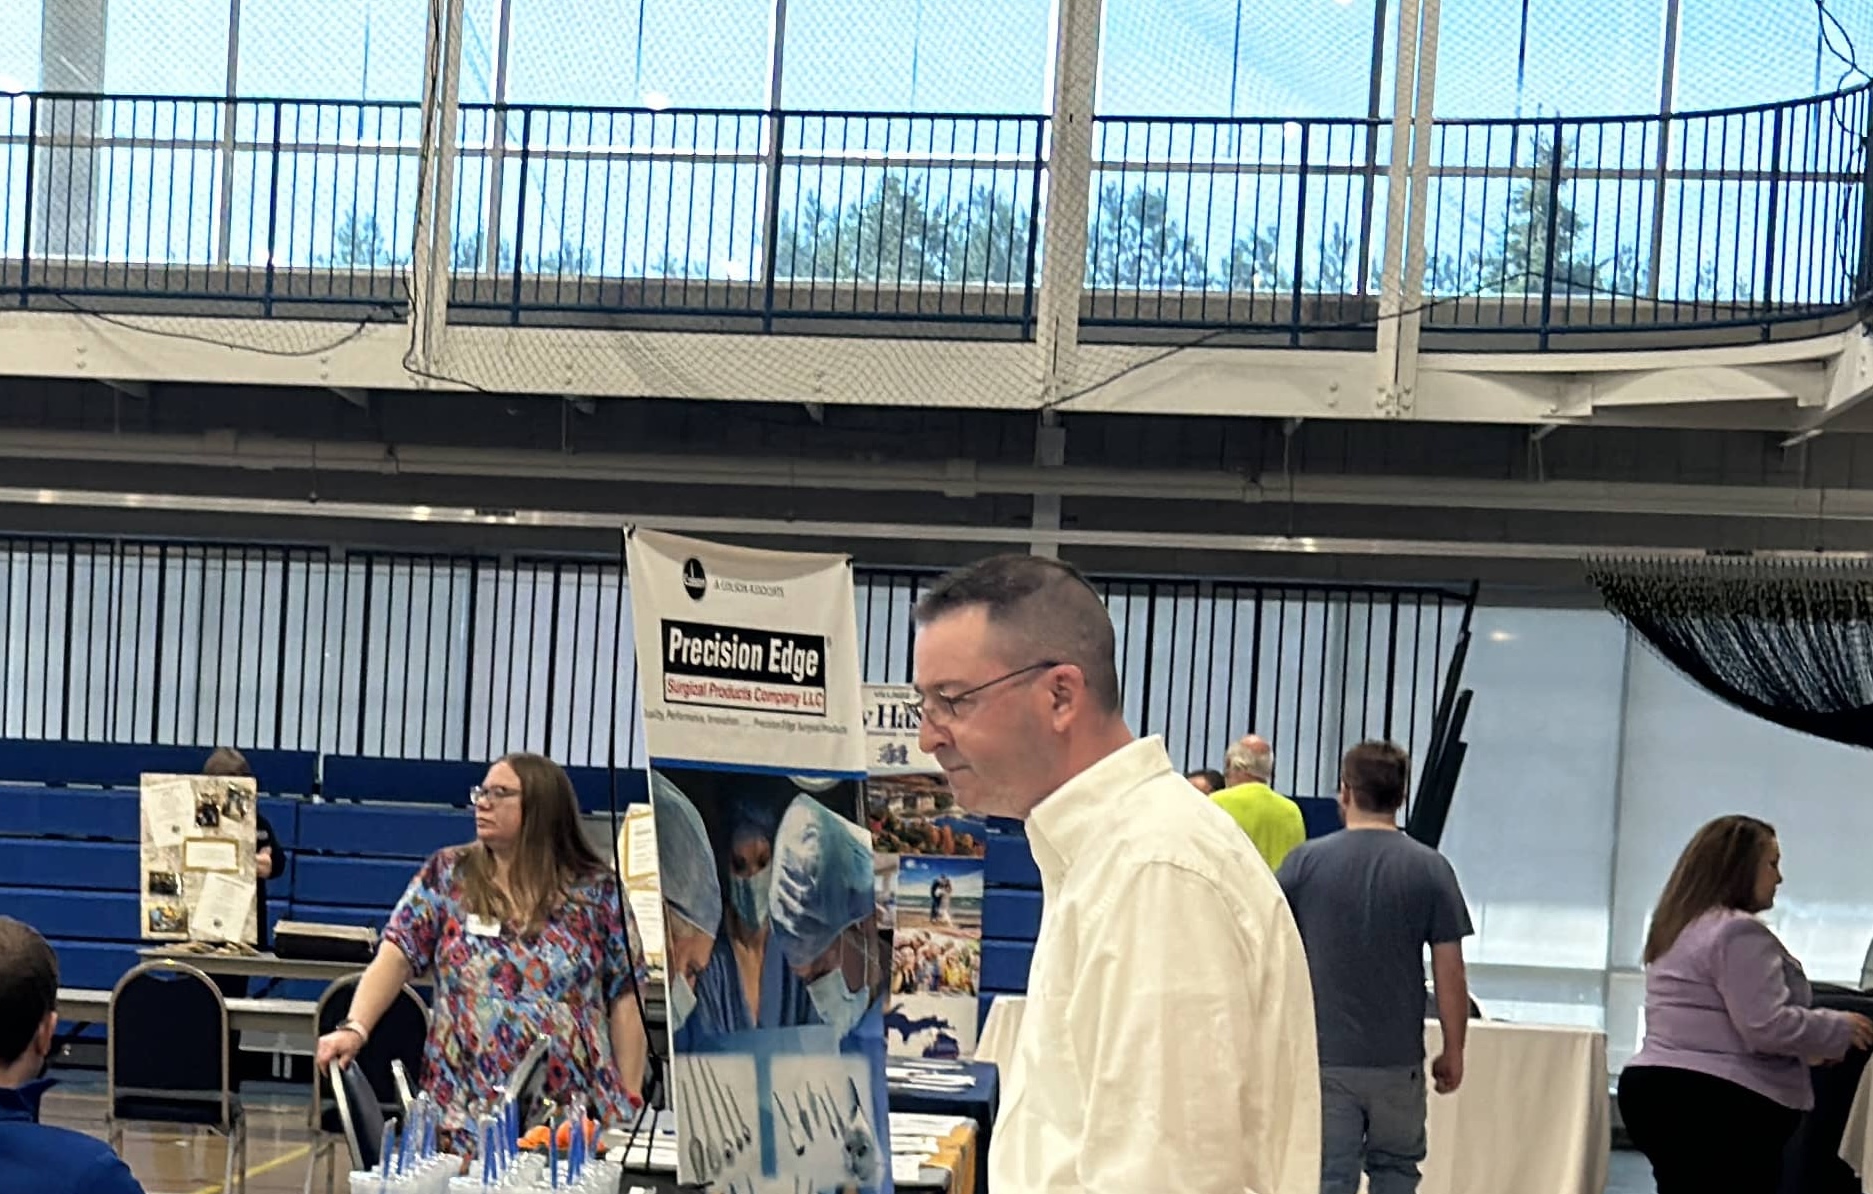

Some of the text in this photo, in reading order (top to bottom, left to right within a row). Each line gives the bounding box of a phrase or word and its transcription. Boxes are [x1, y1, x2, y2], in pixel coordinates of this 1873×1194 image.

[668, 626, 819, 683] Precision Edge
[667, 678, 824, 707] Surgical Products Company LLC
